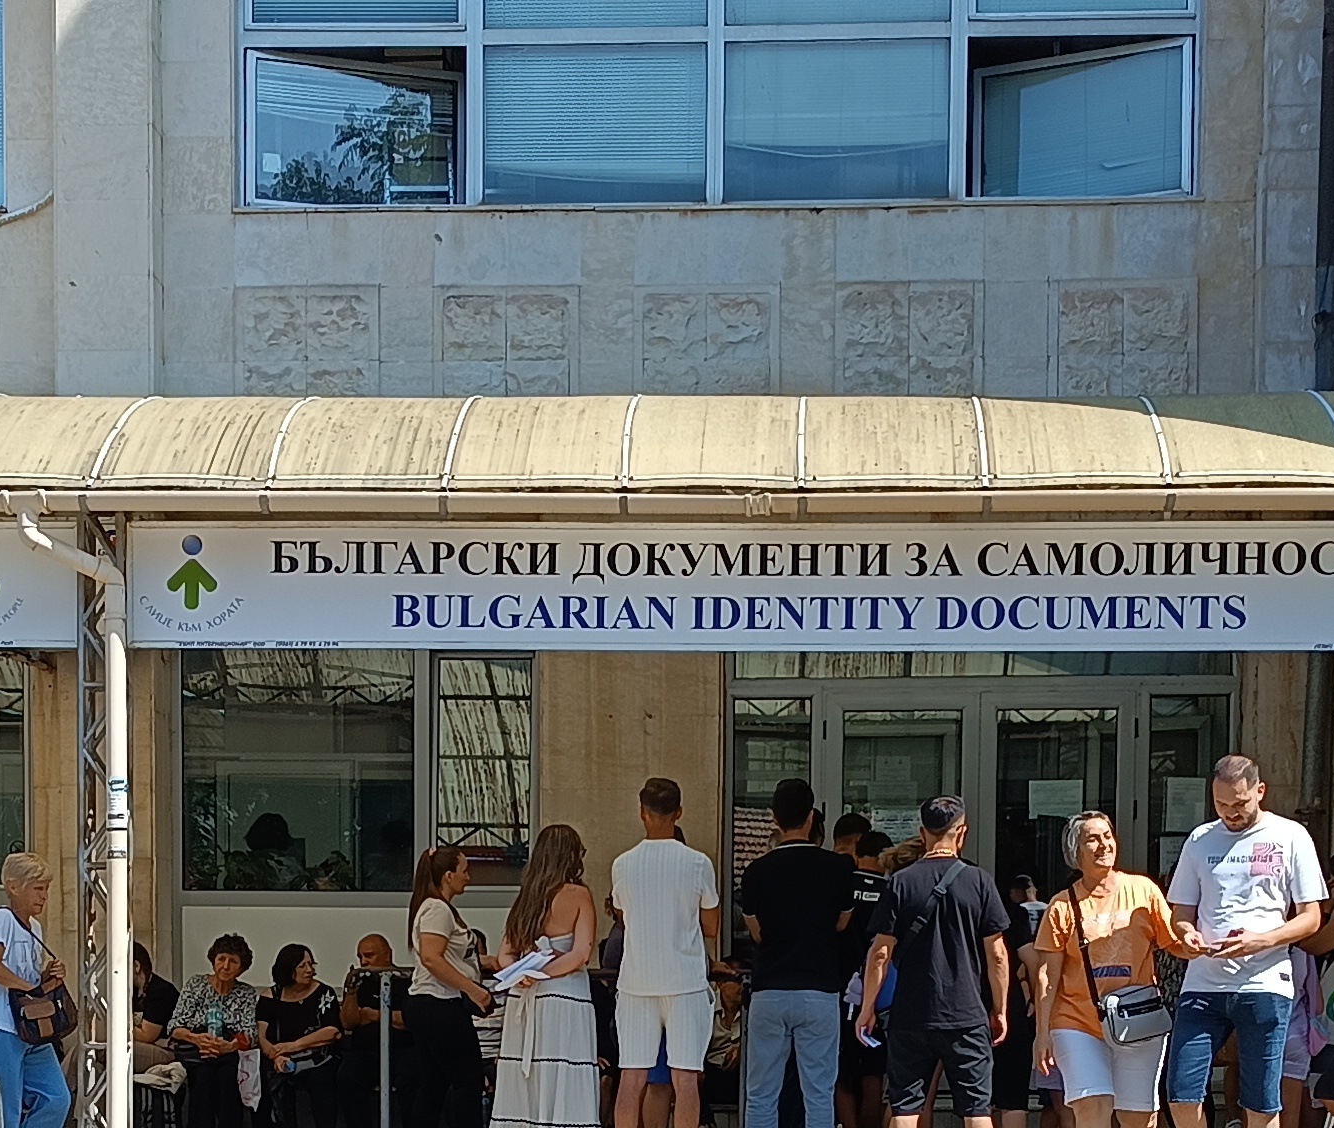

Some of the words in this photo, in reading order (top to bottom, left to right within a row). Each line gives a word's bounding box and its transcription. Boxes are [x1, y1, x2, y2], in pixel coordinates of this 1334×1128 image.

[270, 540, 558, 575] БЪЛГАРСКИ
[572, 540, 893, 584] ДОКУМЕНТИ
[905, 541, 962, 577] ЗА
[206, 597, 245, 630] ХОРАТА
[392, 594, 678, 630] BULGARIAN
[691, 595, 924, 630] IDENTITY
[935, 595, 1247, 631] DOCUMENTS
